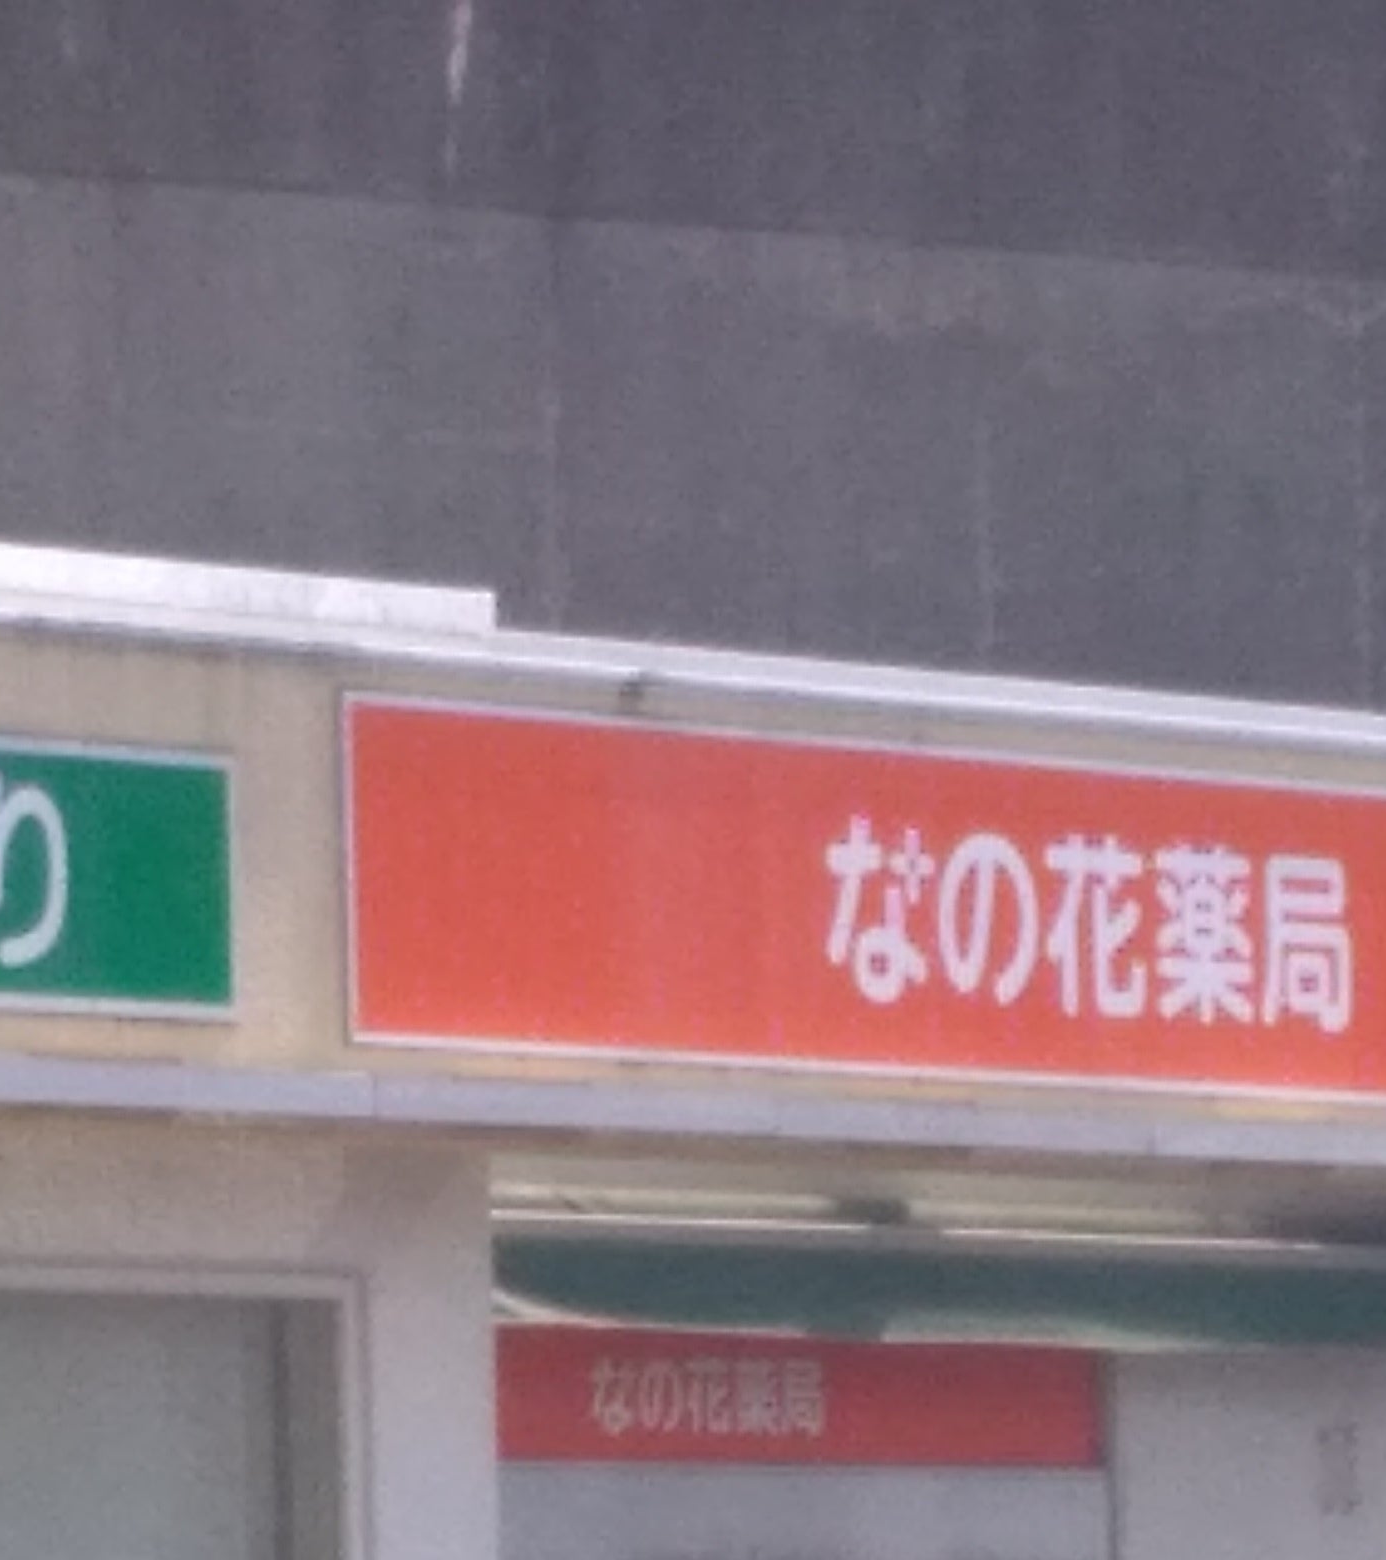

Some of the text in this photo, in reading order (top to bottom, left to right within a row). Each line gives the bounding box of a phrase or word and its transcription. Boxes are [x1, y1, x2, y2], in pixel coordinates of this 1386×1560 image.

[825, 812, 1353, 1033] なの花薬局
[590, 1356, 826, 1437] なの花薬局
